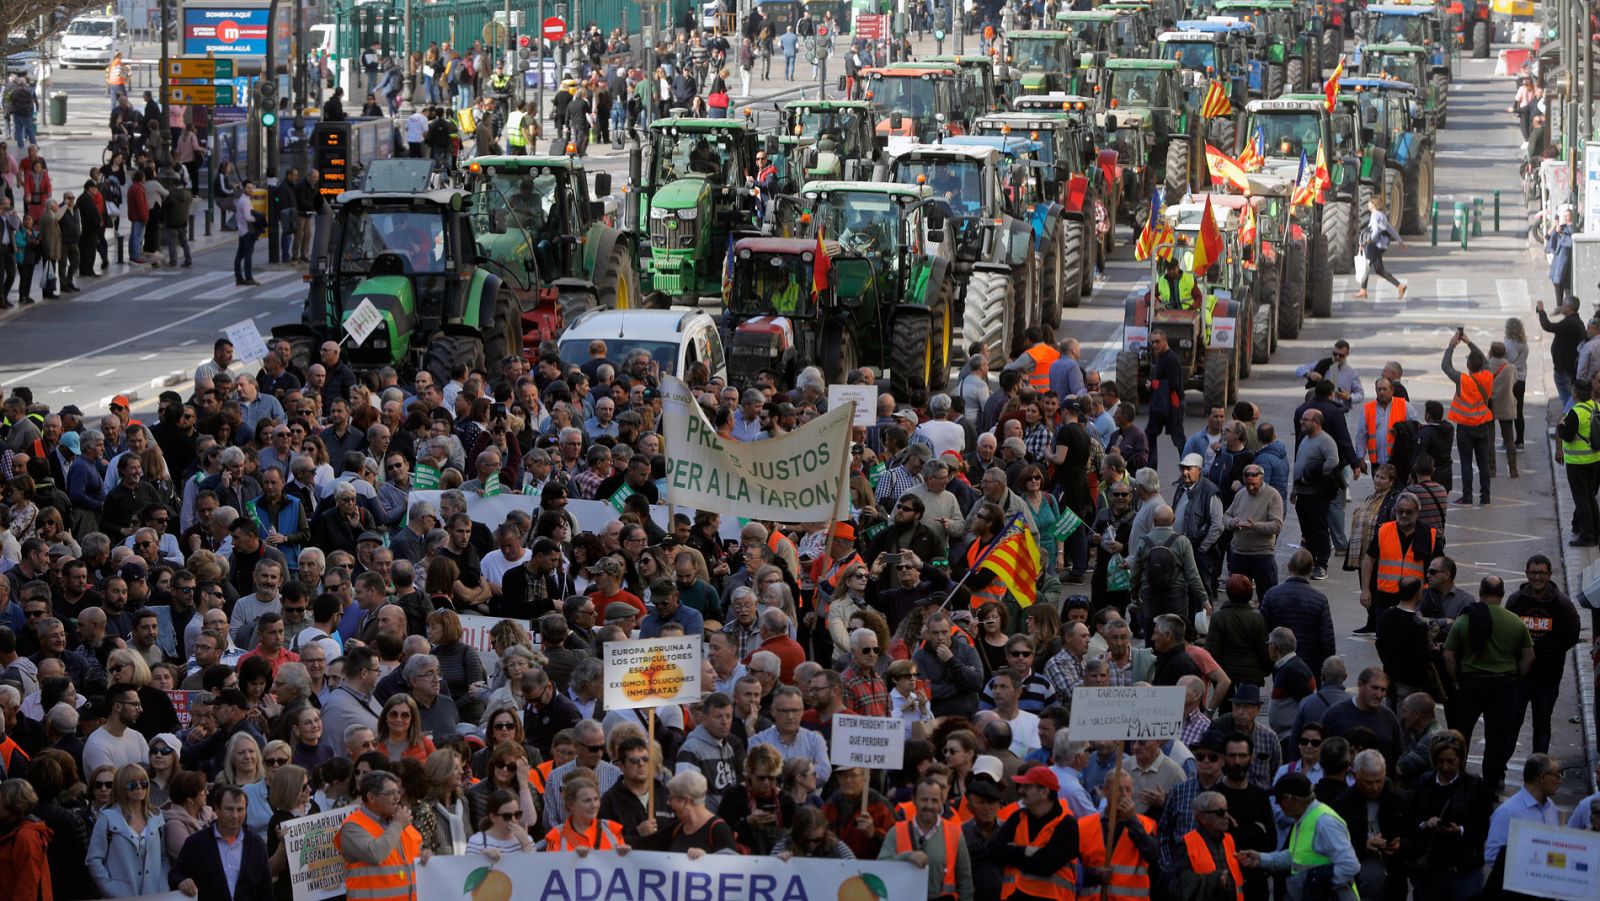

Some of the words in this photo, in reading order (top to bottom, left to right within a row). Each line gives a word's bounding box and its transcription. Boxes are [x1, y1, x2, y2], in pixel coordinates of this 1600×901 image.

[749, 442, 830, 481] JUSTOS
[667, 459, 703, 491] PER
[706, 468, 721, 496] A
[726, 473, 750, 503] LA
[758, 476, 840, 510] TARONJ
[611, 647, 645, 656] EUROPA
[647, 644, 684, 653] ARRUINA
[612, 658, 628, 666] LOS
[630, 653, 693, 664] CITRICULTORES
[629, 663, 677, 673] ESPAÑOLES
[609, 679, 646, 688] EXIGIMOS
[648, 676, 695, 685] SOLUCIONES
[627, 687, 678, 697] INMEDIATAS
[1097, 689, 1138, 698] TARONJA
[838, 717, 858, 727] ESTEM
[859, 719, 885, 730] PERDENT
[886, 720, 901, 730] TANT
[1127, 720, 1182, 737] MATEU!
[849, 735, 861, 745] QUE
[862, 737, 889, 747] PERDREM
[850, 752, 863, 762] FINS
[864, 754, 872, 764] LA
[873, 754, 885, 764] POR
[289, 821, 314, 838] EUROPA
[290, 839, 304, 853] LOS
[292, 869, 320, 885] EXIGIMOS
[322, 861, 345, 877] SOLUCI
[539, 868, 810, 901] ADARIBERA
